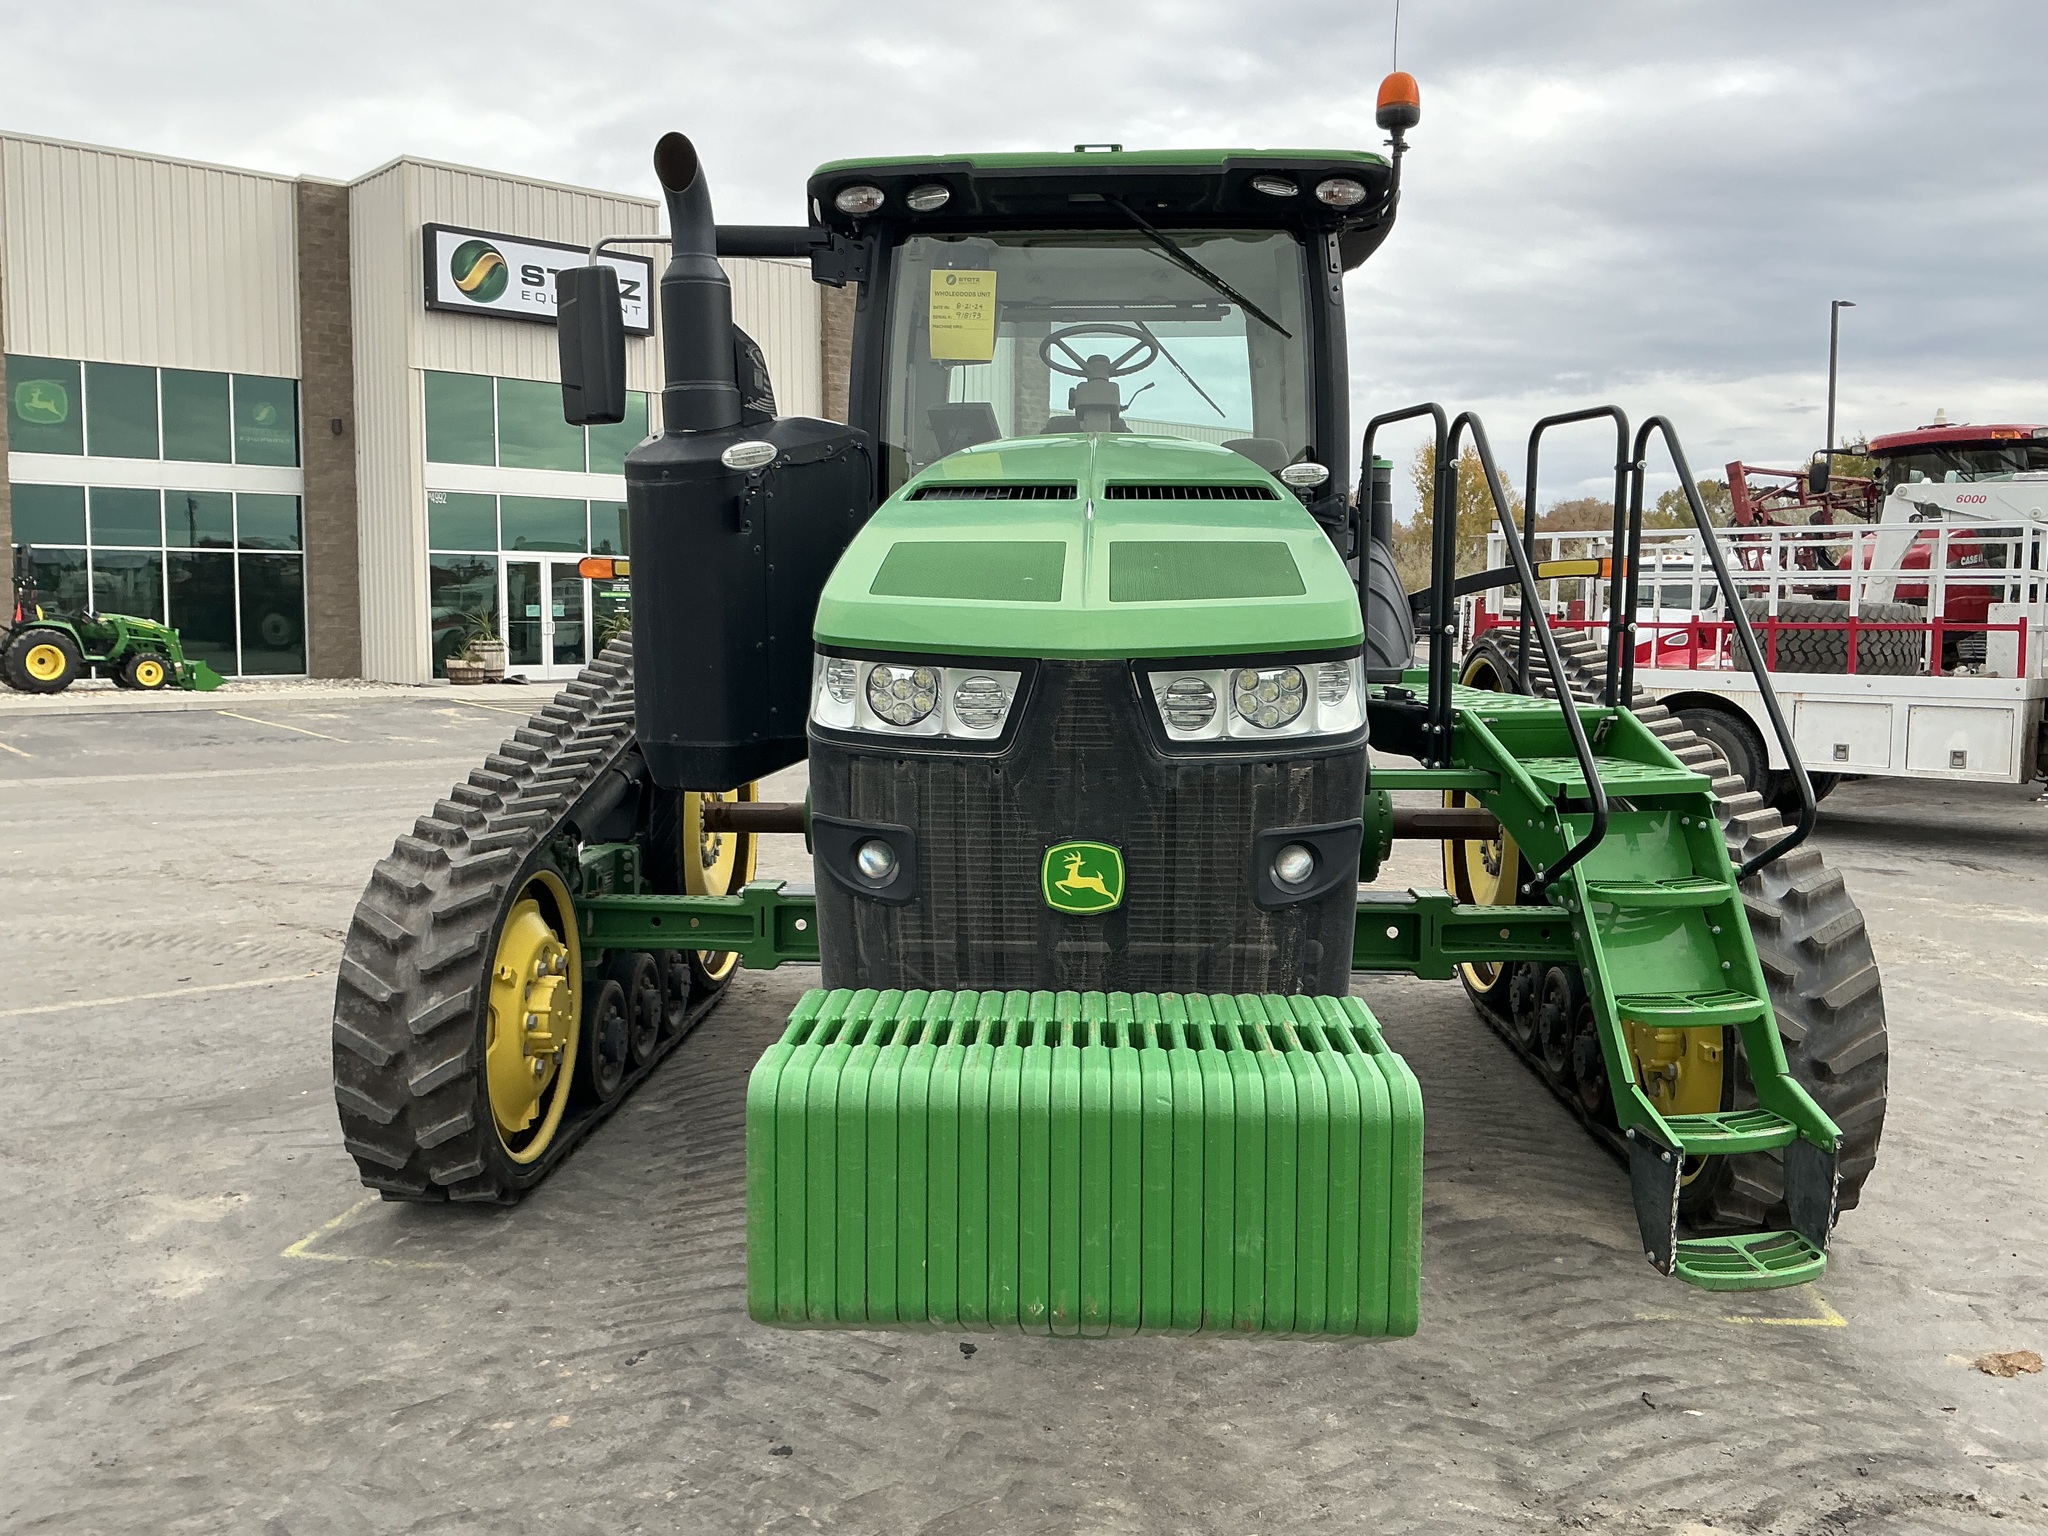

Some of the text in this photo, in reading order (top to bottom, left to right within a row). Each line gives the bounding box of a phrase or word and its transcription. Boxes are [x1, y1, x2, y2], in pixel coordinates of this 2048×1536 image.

[521, 264, 641, 302] STZ
[521, 290, 641, 315] EQUNT
[1956, 494, 1987, 504] 6000
[1960, 554, 1978, 566] CASE
